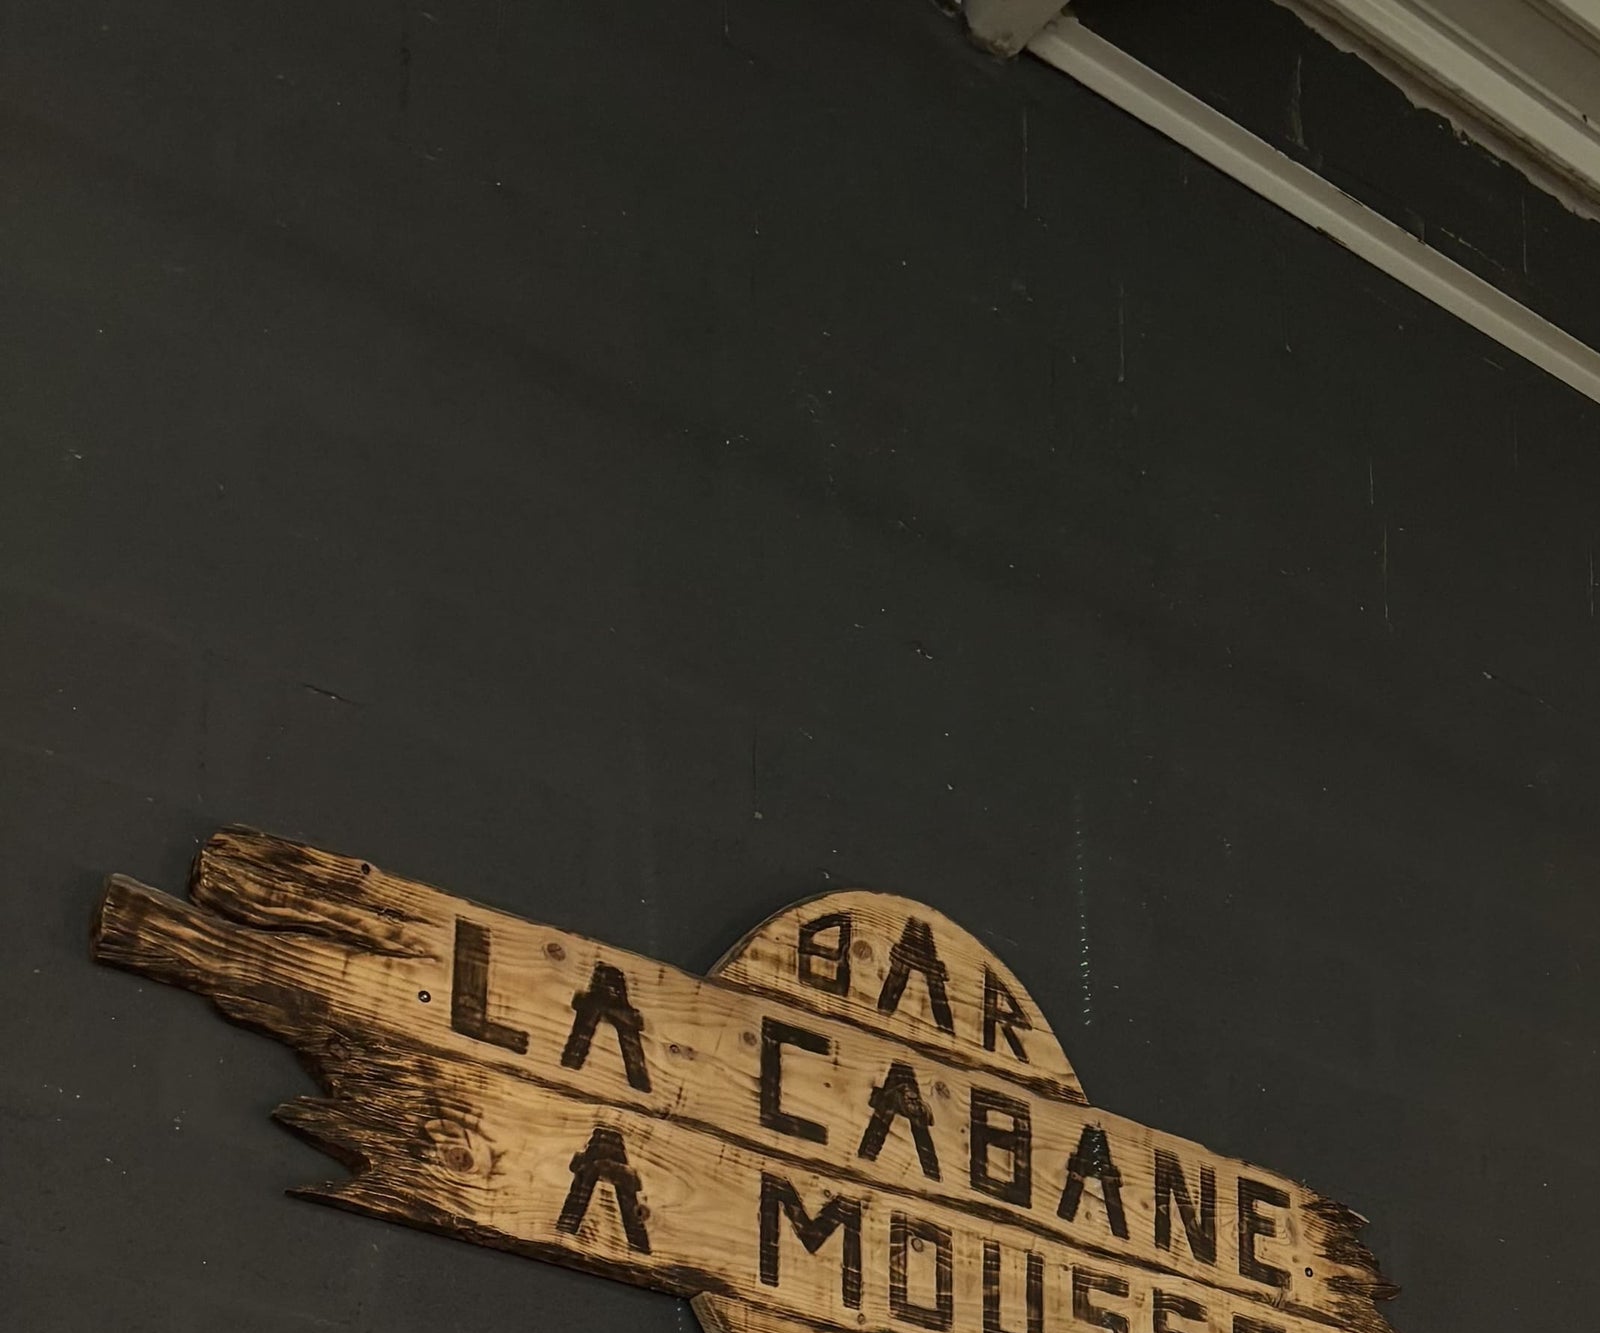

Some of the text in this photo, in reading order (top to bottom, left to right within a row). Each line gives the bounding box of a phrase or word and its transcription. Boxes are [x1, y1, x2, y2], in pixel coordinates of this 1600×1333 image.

[801, 910, 1029, 1066] BAR
[451, 915, 1294, 1290] LA CABANE
[555, 1127, 651, 1254] A
